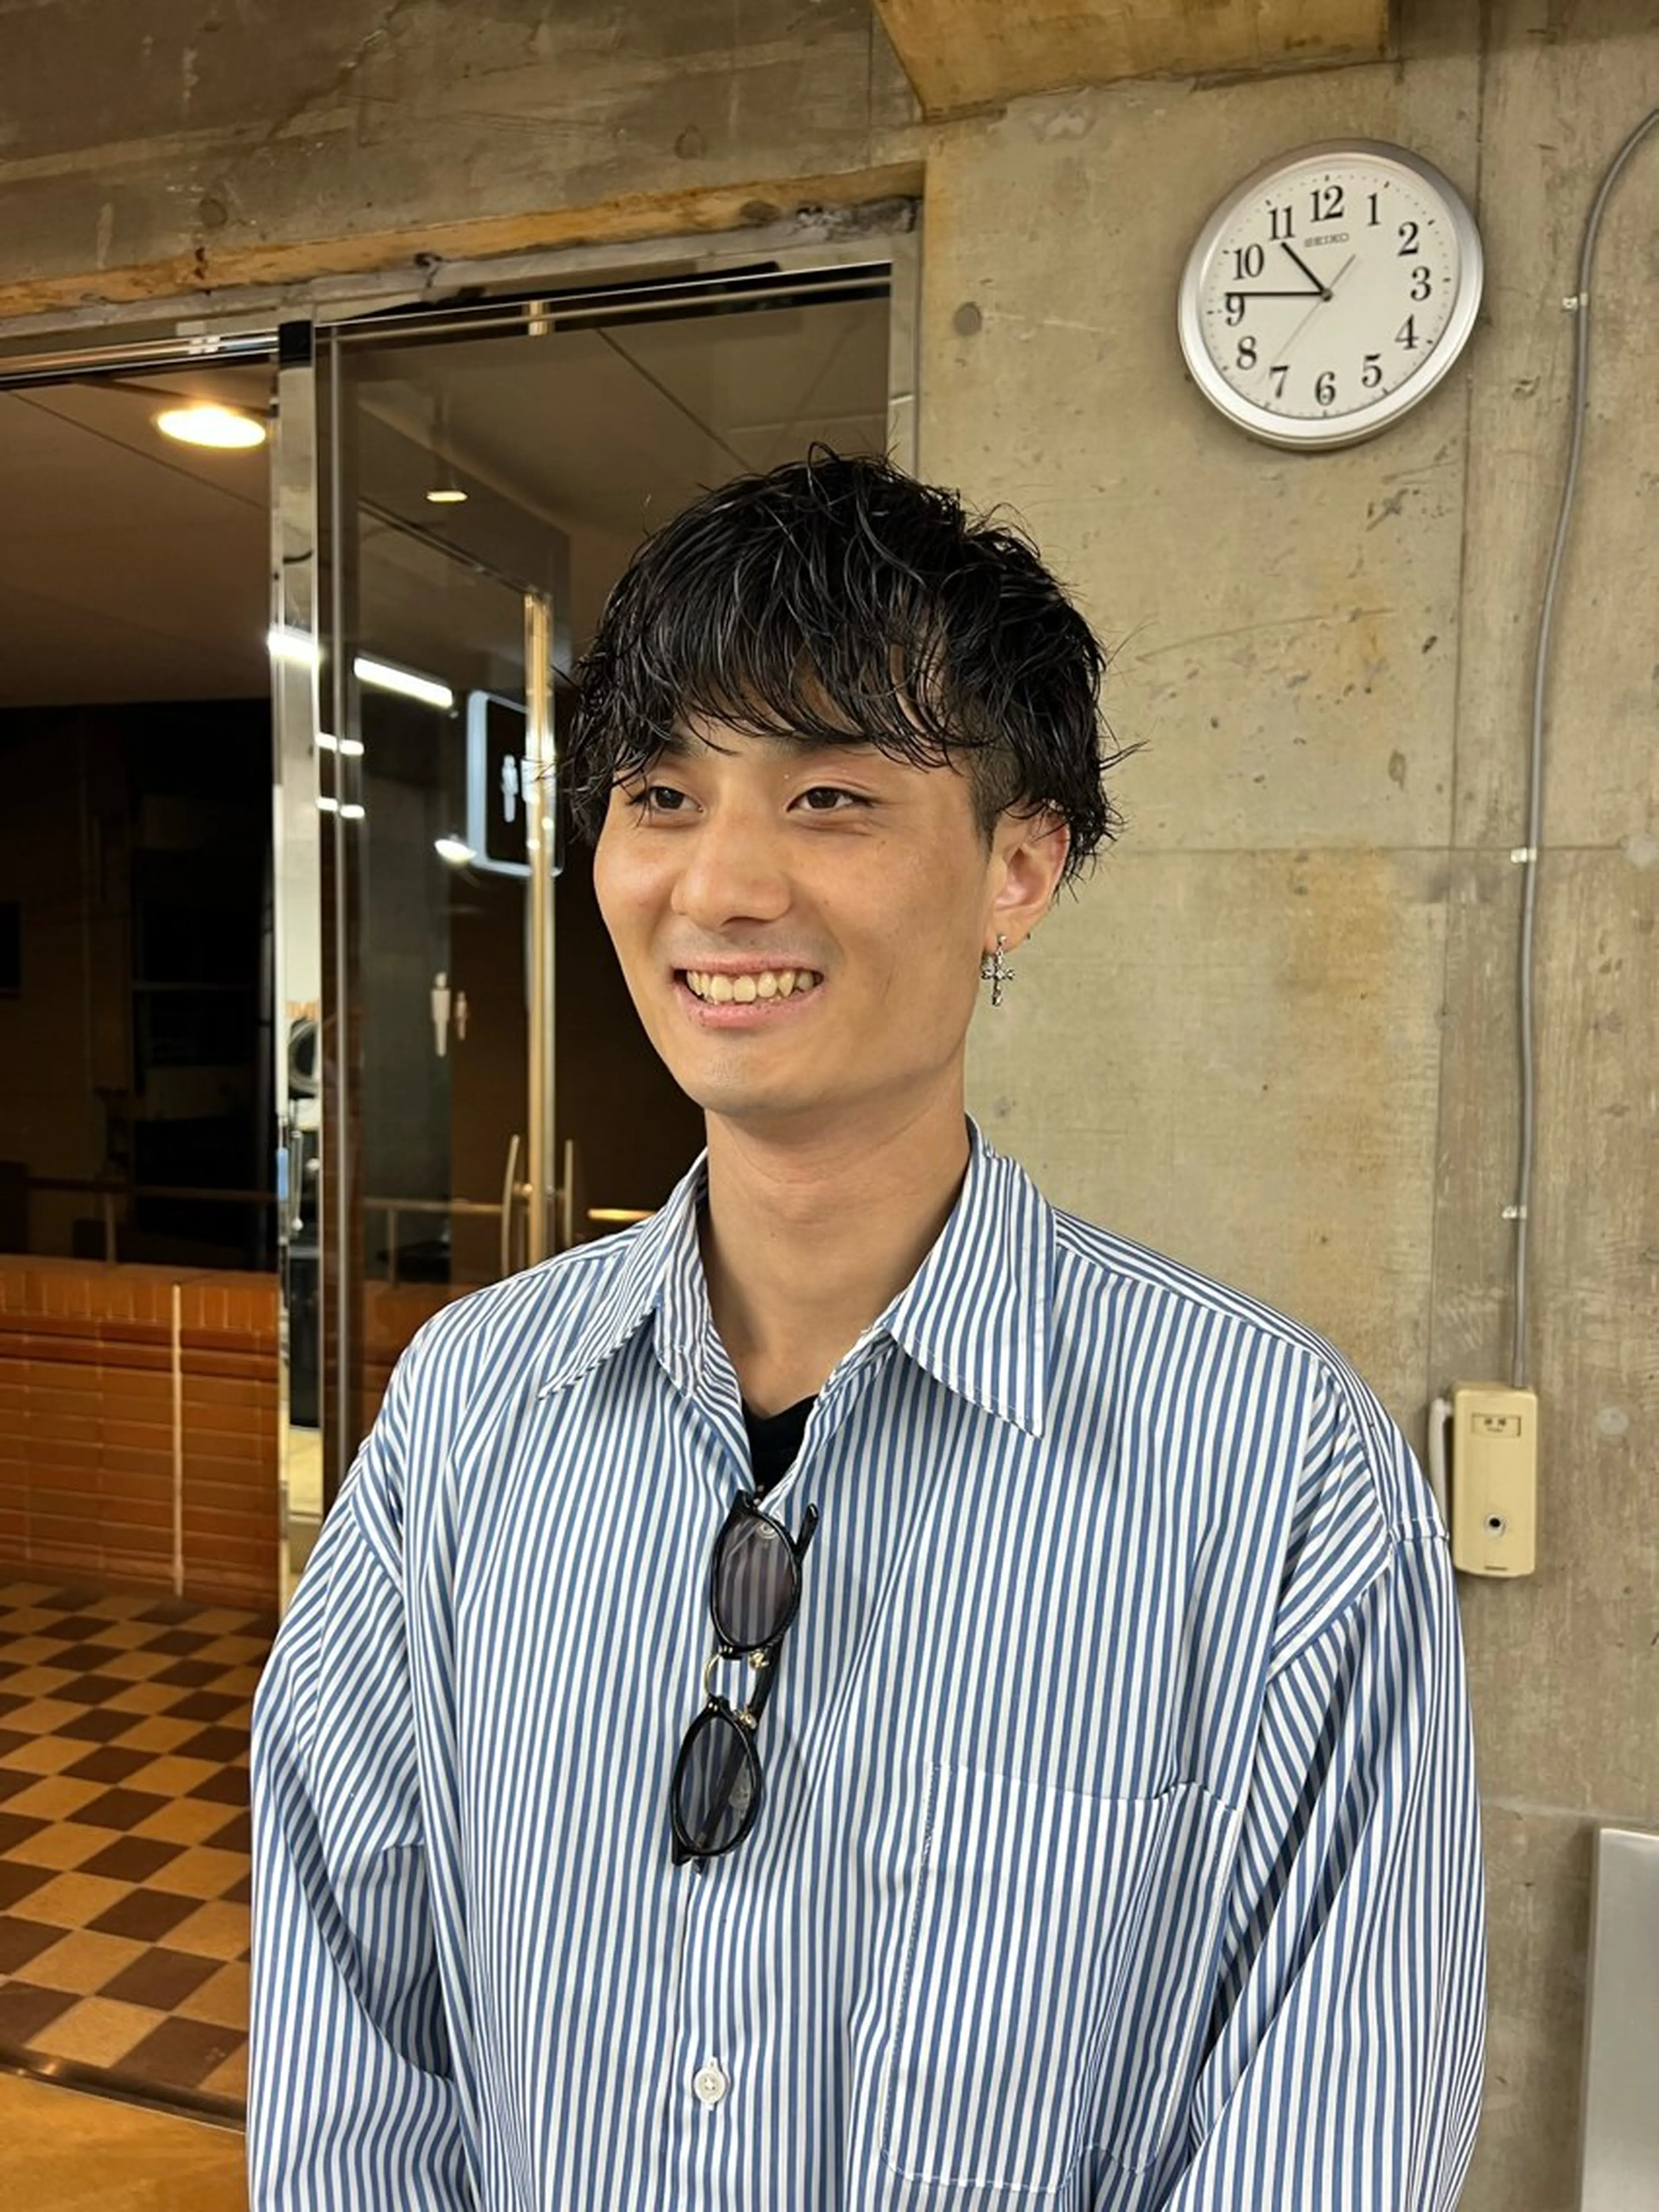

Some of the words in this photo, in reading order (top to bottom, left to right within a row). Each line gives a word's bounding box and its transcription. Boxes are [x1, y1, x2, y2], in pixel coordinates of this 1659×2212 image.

[1311, 185, 1344, 222] 12
[1367, 193, 1380, 226] 1
[1268, 206, 1295, 241] 11
[1304, 232, 1350, 248] SEIKO
[1398, 222, 1419, 257] 2
[1233, 244, 1265, 280] 10
[1411, 267, 1431, 301] 3
[1225, 295, 1245, 327] 9
[1395, 315, 1419, 350] 4
[1236, 336, 1257, 370] 8
[1362, 353, 1382, 388] 5
[1269, 365, 1290, 398] 7
[1315, 371, 1336, 406] 6
